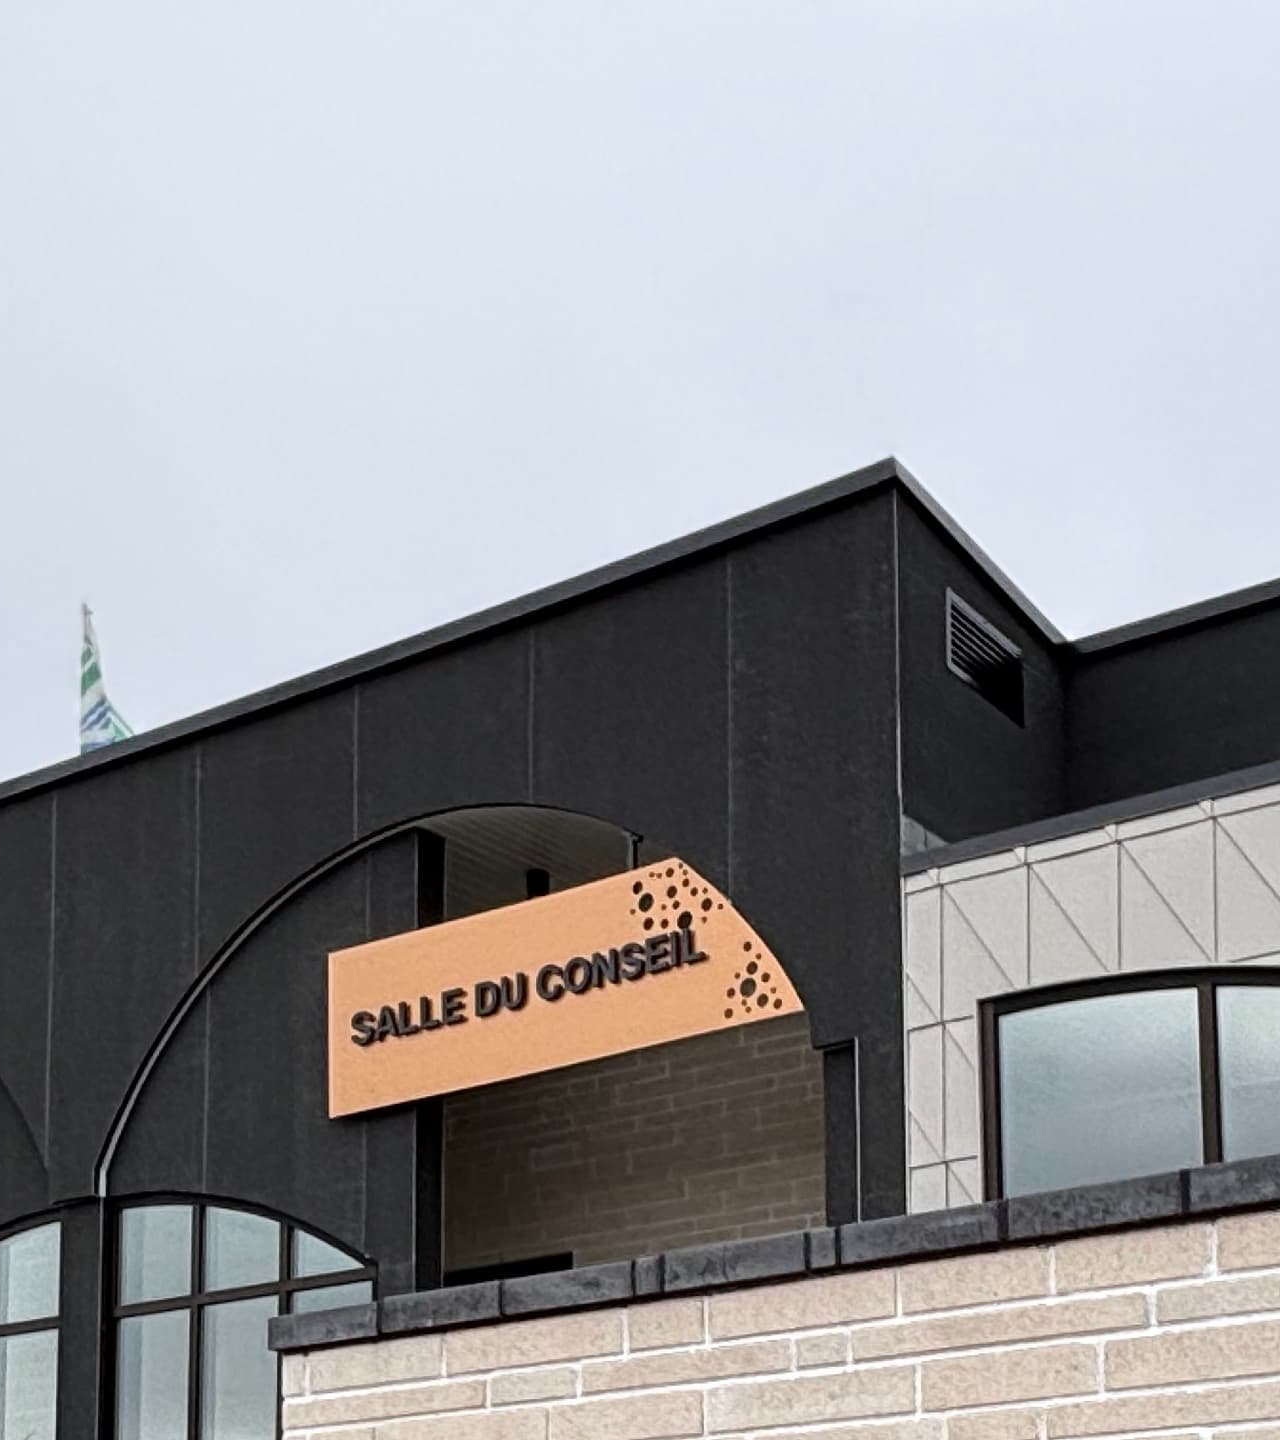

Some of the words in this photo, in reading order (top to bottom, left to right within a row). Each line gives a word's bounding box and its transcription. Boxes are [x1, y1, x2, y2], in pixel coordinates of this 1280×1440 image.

[351, 988, 467, 1045] SALLE
[474, 972, 529, 1018] DU
[536, 928, 707, 1000] CONSEIL
